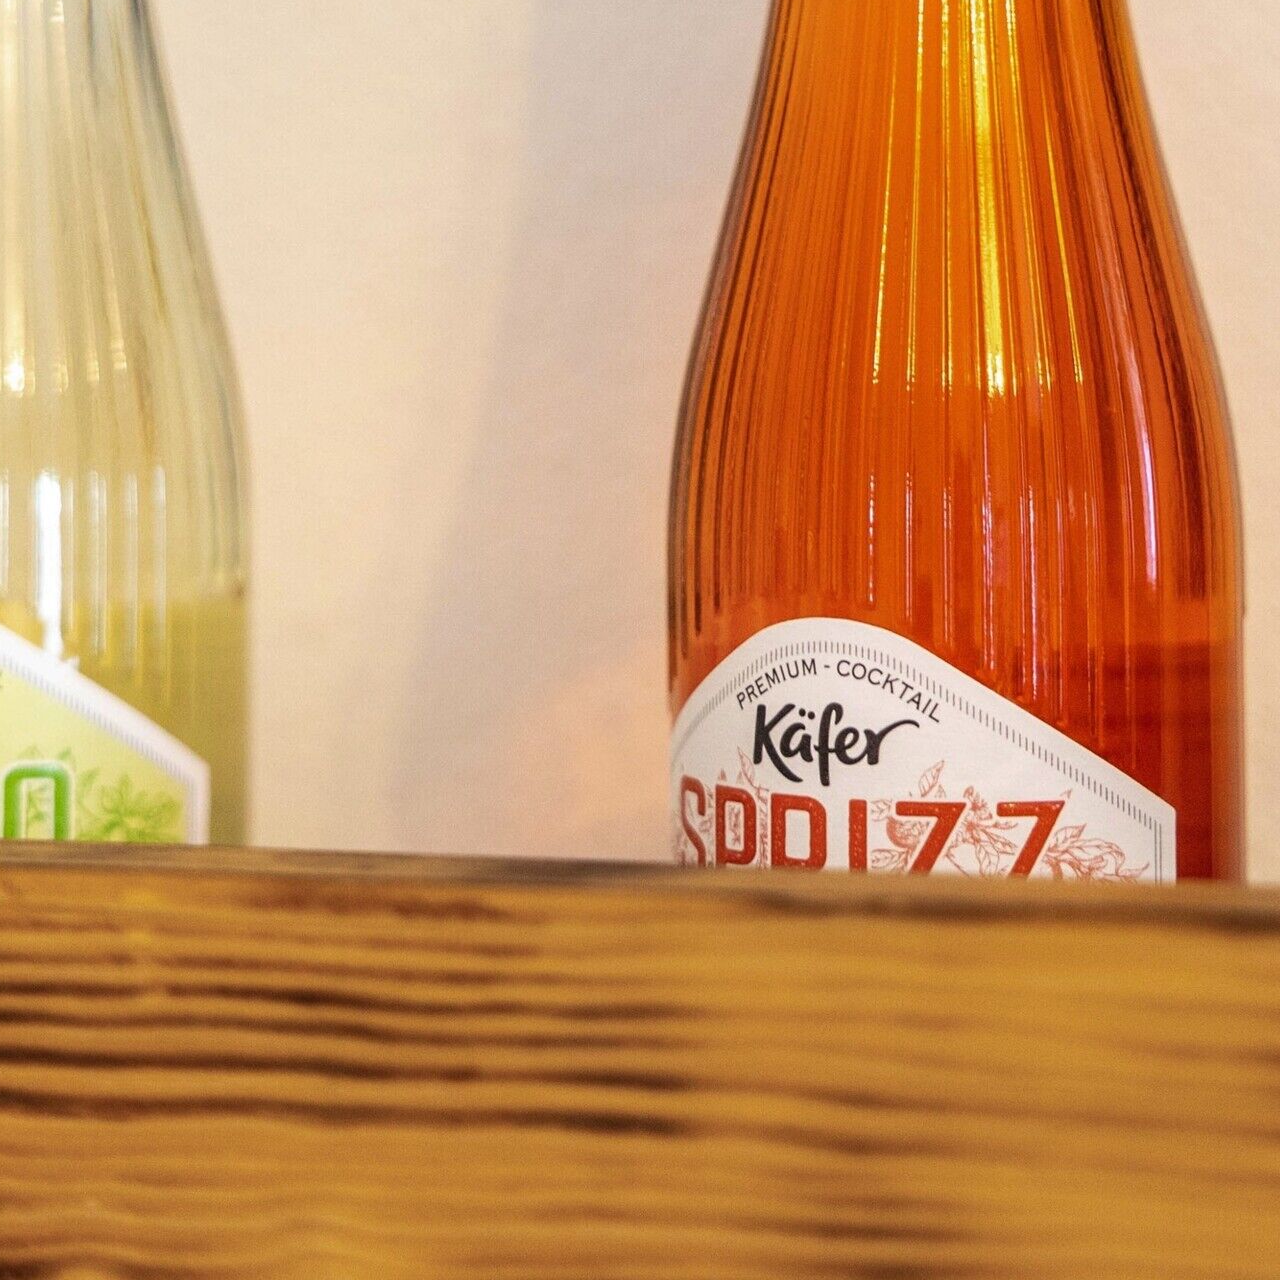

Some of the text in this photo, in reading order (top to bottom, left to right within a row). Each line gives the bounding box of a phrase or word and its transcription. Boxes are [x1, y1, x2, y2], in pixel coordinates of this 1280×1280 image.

[736, 657, 818, 711] PREMIUM
[836, 658, 942, 724] COCKTAIL
[752, 701, 922, 787] Käfer
